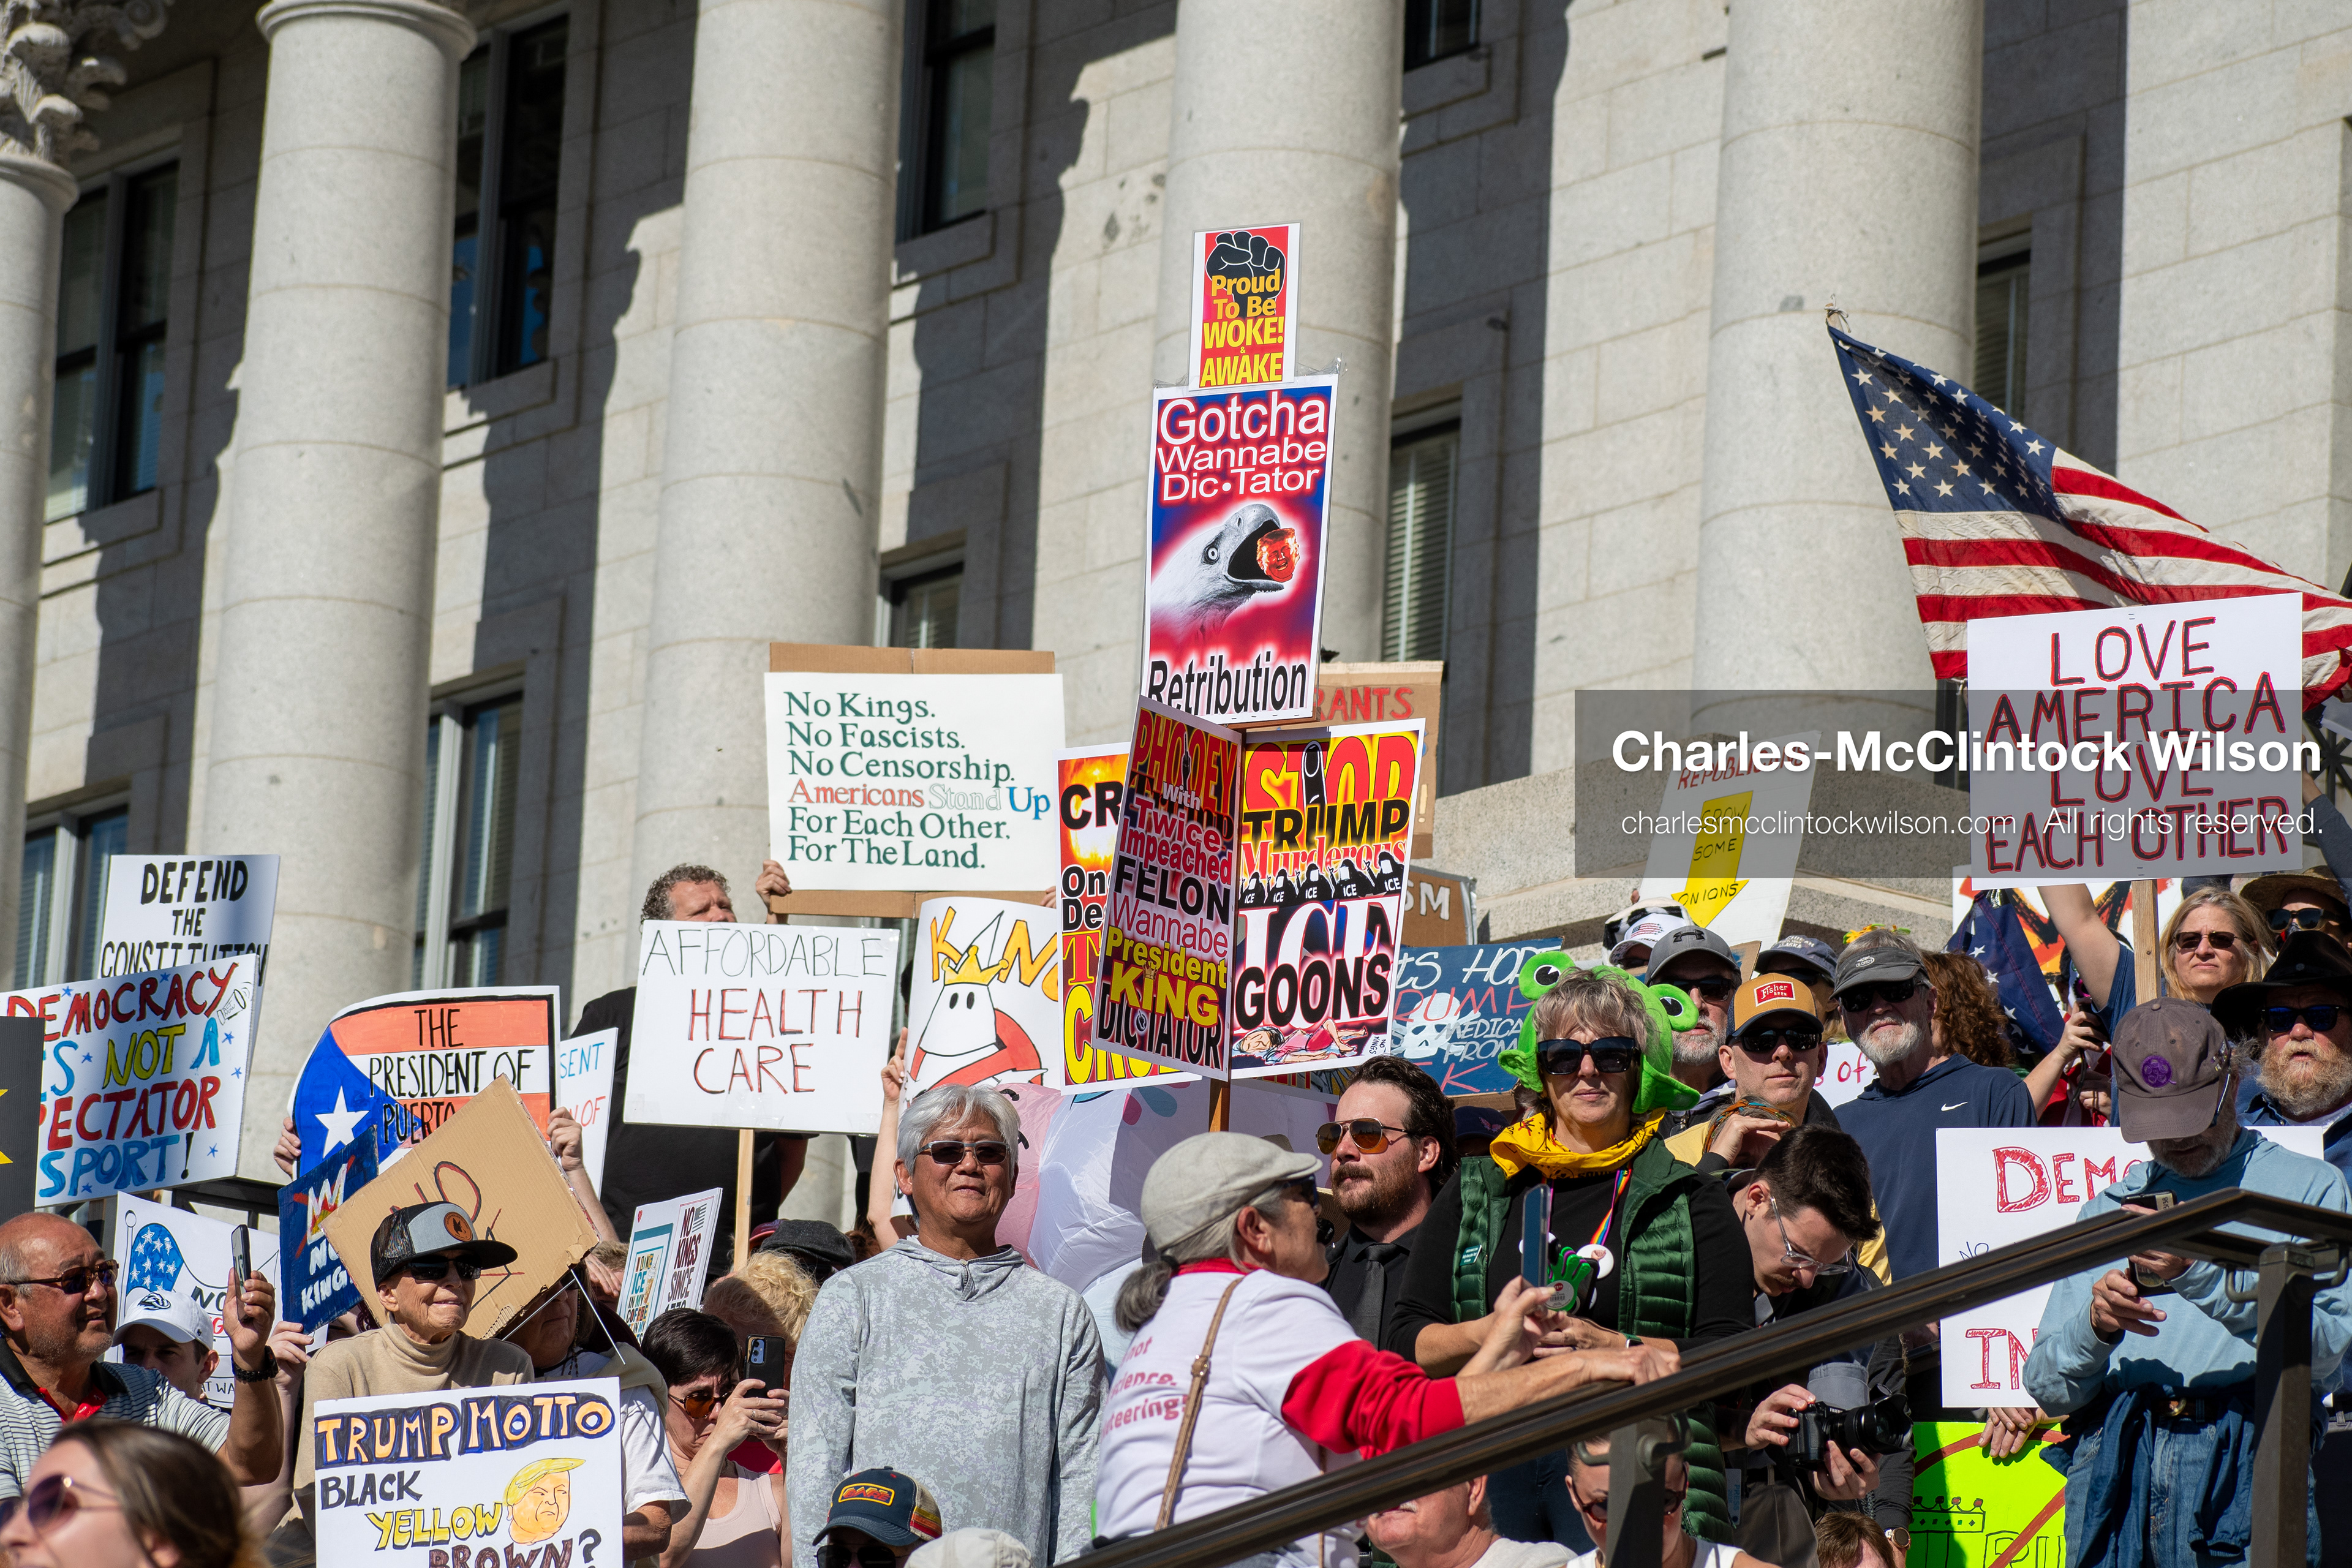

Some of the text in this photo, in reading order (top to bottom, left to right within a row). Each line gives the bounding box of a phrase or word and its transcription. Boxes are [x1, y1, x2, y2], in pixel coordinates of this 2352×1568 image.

[1211, 268, 1281, 296] Proud
[1213, 295, 1276, 320] To Be
[1203, 316, 1284, 349] WOKE!
[1240, 345, 1246, 354] &
[1199, 352, 1283, 387] AWAKE
[1160, 391, 1325, 445] Gotcha
[1157, 437, 1326, 473] Wannabe
[2050, 616, 2215, 687] LOVE
[1148, 651, 1306, 716] Retribution
[783, 692, 936, 725] No Kings.
[1984, 672, 2286, 753] AMERICA
[785, 721, 965, 748] No Fascists.
[788, 750, 1015, 788] No Censorship.
[1132, 707, 1238, 816] PHOOEY
[1245, 736, 1415, 812] STOP
[2051, 739, 2214, 808] LOVE
[788, 778, 1050, 820] Americans Stand Up
[1163, 782, 1201, 811] With
[788, 807, 1011, 840] For Each Other,
[1135, 797, 1220, 852] Twice
[1243, 799, 1410, 850] TRUMP
[1985, 811, 2104, 873] EACH
[2132, 796, 2288, 861] OTHER
[788, 835, 986, 869] For The Land.
[1120, 818, 1232, 886] Impeached
[1241, 837, 1406, 879] Murderous
[1693, 838, 1737, 861] SOME
[141, 859, 249, 904] DEFEND
[1114, 855, 1230, 925] FELON
[1244, 893, 1255, 903] ICE
[1273, 891, 1284, 902] ICE
[1305, 887, 1317, 899] ICE
[1343, 884, 1357, 897] ICE
[1384, 878, 1401, 891] ICE
[1678, 883, 1738, 907] ONIONS
[172, 907, 206, 937] THE
[1113, 892, 1228, 958] Wannabe
[643, 929, 887, 978] AFFORDABLE
[1105, 925, 1227, 989] President
[1110, 961, 1219, 1027] KING
[1235, 953, 1390, 1030] GOONS
[1761, 984, 1788, 999] Fisher
[413, 1008, 464, 1047] THE
[688, 989, 862, 1041] HEALTH
[103, 1023, 186, 1090] NOT
[190, 1017, 221, 1069] A
[1369, 1036, 1380, 1054] KINGS
[1443, 1038, 1518, 1063] FROM
[369, 1049, 535, 1098] PRESIDENT OF
[693, 1043, 815, 1095] CARE
[39, 1076, 221, 1151] ECTATOR
[680, 1206, 695, 1238] NO
[674, 1233, 701, 1270] KINGS
[301, 1265, 353, 1316] KING
[628, 1294, 644, 1308] IN MY
[631, 1270, 647, 1294] ICE
[668, 1267, 695, 1303] SINCE
[627, 1302, 649, 1323] COFFEE
[317, 1395, 613, 1463] TRUMP MOTTO
[320, 1470, 423, 1510] BLACK
[365, 1502, 502, 1551] YELLOW
